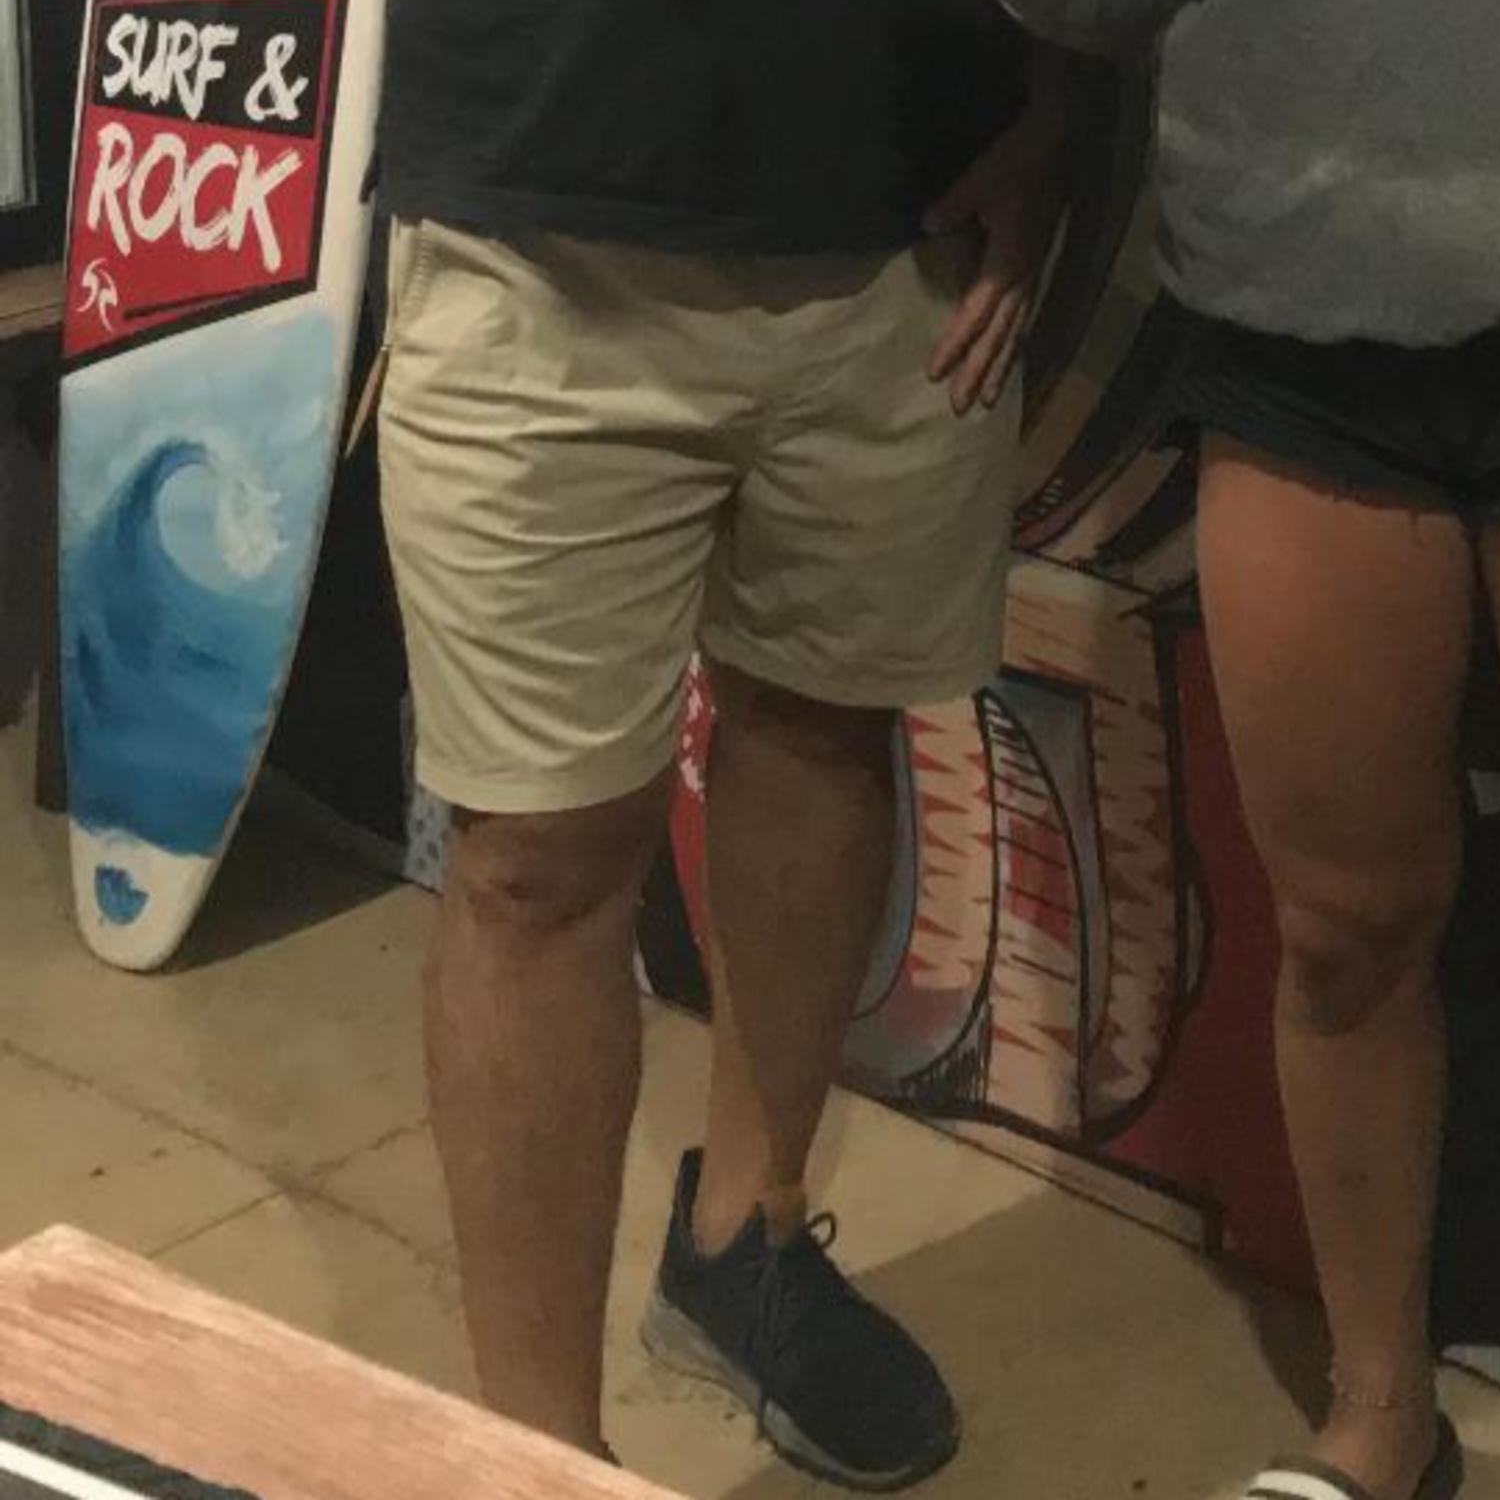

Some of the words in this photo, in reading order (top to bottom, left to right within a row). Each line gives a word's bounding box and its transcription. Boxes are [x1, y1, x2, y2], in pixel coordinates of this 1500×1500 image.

[102, 13, 238, 120] SURF
[244, 32, 309, 122] &
[87, 121, 303, 275] ROCK
